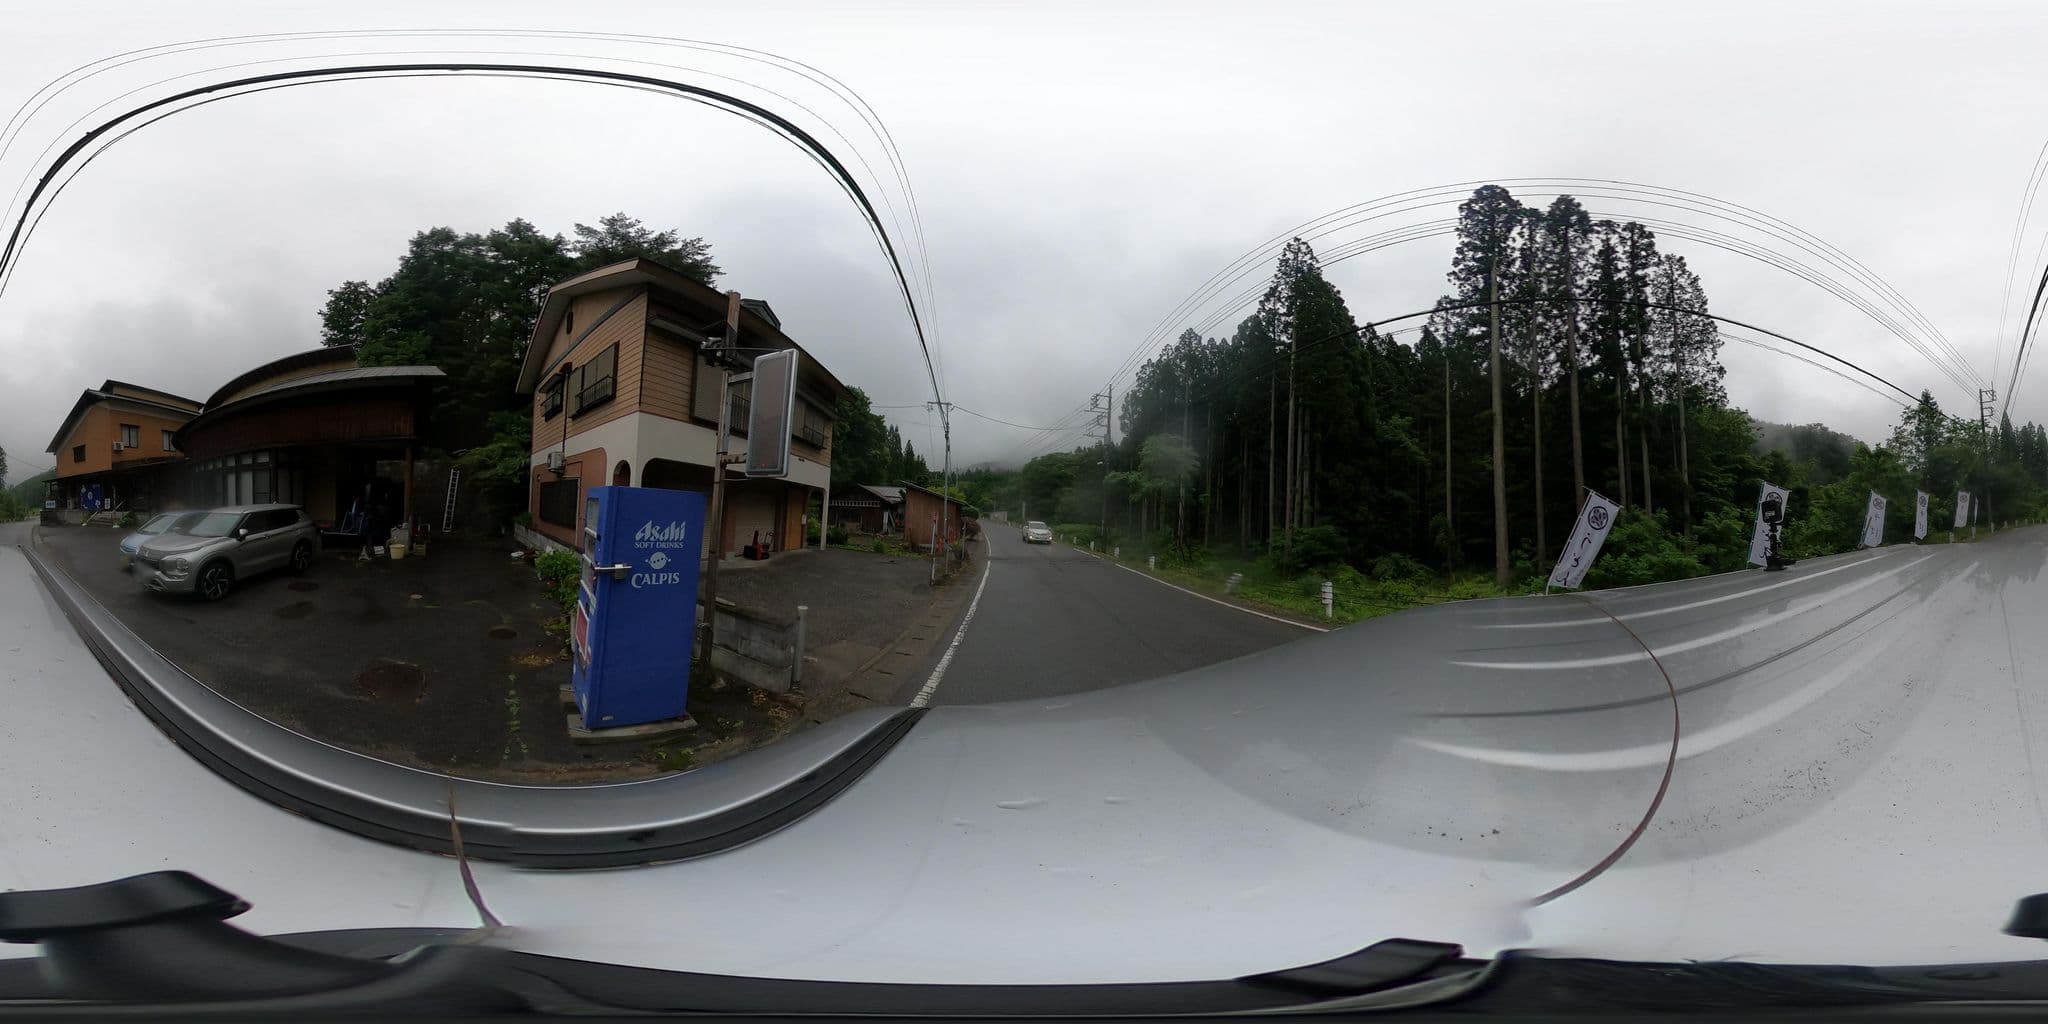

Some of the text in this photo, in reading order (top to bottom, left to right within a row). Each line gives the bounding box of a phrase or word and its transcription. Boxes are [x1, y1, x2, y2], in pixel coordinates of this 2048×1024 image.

[635, 520, 686, 541] Asahi
[635, 541, 684, 549] SOFT DRINKS
[631, 572, 680, 588] CALPIS
